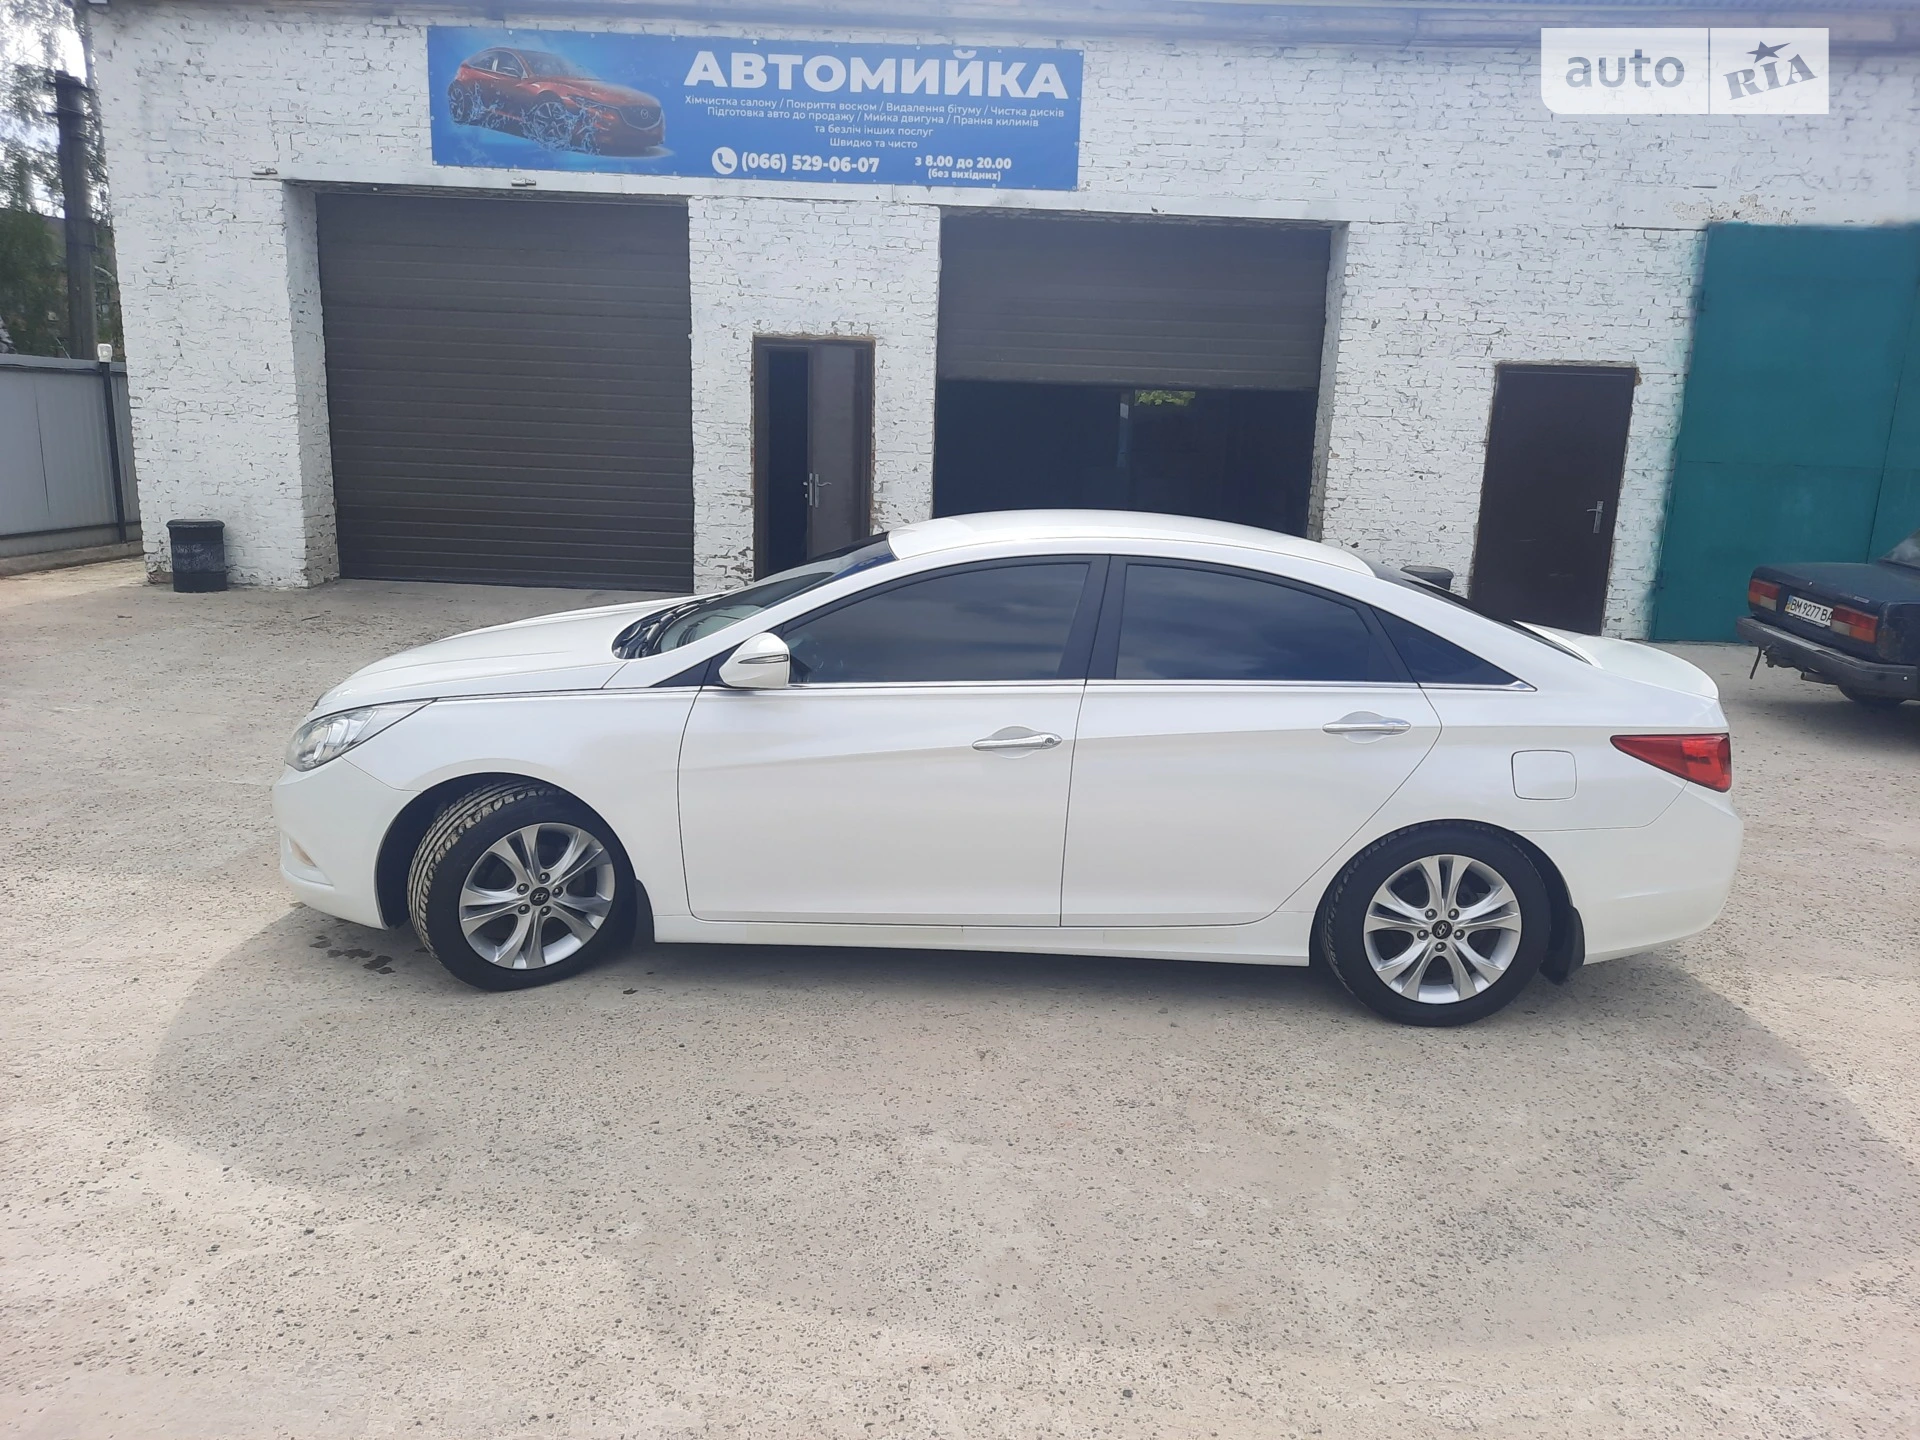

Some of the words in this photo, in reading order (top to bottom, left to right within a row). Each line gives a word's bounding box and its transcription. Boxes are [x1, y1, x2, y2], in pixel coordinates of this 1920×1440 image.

[683, 49, 1069, 99] АВТОМИЙКА
[685, 95, 738, 107] Хімчистка
[740, 99, 777, 110] салону
[786, 99, 836, 112] Покриття
[839, 103, 877, 111] воском
[886, 102, 945, 114] Видалення
[947, 104, 983, 117] бітуму
[990, 106, 1027, 116] Чистка
[1029, 107, 1065, 118] дисків
[707, 106, 765, 118] Підготовка
[767, 111, 790, 119] авто
[792, 112, 806, 120] до
[808, 113, 854, 123] продажу
[864, 112, 898, 122] Мийка
[900, 115, 944, 125] двигуна
[953, 116, 993, 126] Прання
[995, 118, 1039, 127] килимів
[814, 125, 825, 133] та
[828, 124, 861, 134] безліч
[864, 126, 895, 136] інших
[898, 128, 934, 137] послуг
[829, 138, 872, 149] Швидко
[888, 140, 918, 149] чисто
[741, 152, 787, 174] (066)
[791, 154, 880, 173] 529-06-07
[925, 155, 953, 168] 8.00
[956, 158, 973, 169] до
[976, 157, 1012, 169] 20.00
[928, 168, 949, 180] (без
[951, 170, 1001, 182] вихідних)
[1802, 602, 1821, 619] 9277
